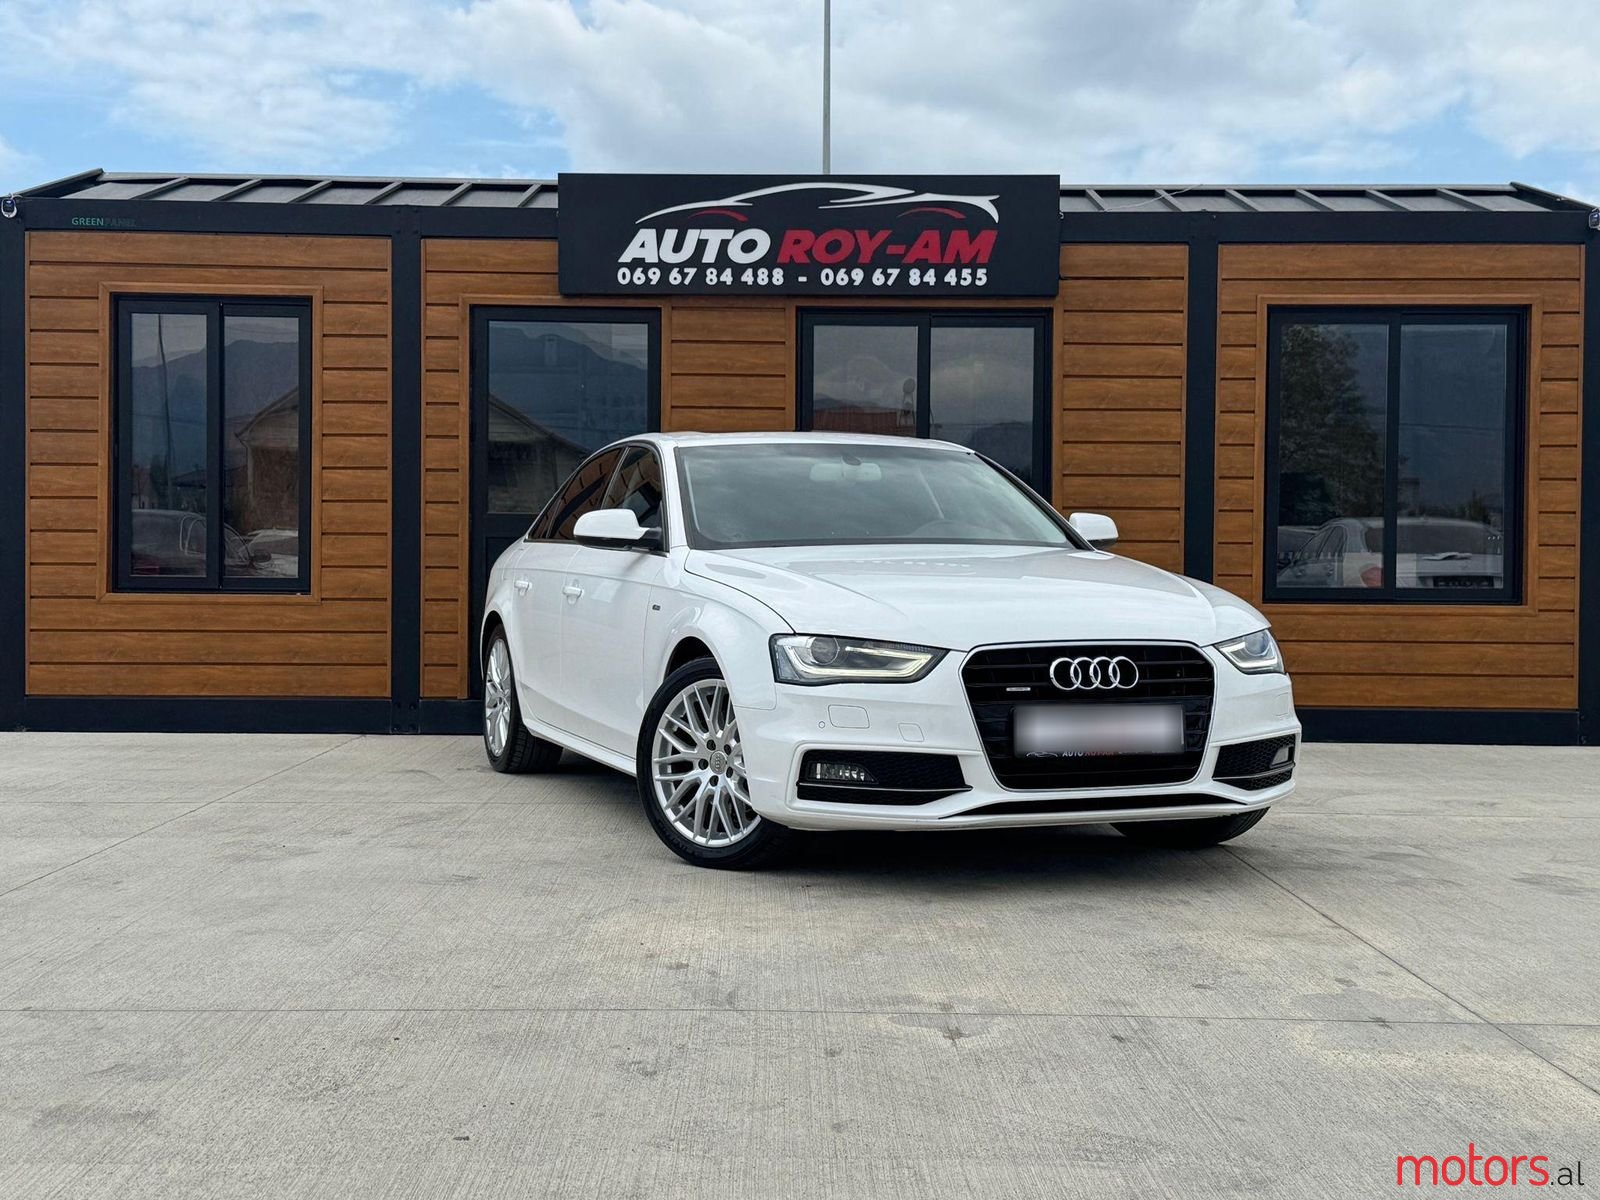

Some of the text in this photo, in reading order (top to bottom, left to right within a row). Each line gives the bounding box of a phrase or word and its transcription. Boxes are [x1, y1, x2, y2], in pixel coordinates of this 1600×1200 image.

[617, 228, 998, 265] AUTO ROY-AM
[616, 267, 661, 287] 069
[668, 267, 698, 287] 67
[705, 267, 734, 287] 84
[740, 267, 785, 287] 488
[820, 267, 865, 287] 069
[871, 267, 901, 288] 67
[908, 267, 937, 288] 84
[943, 267, 988, 288] 455
